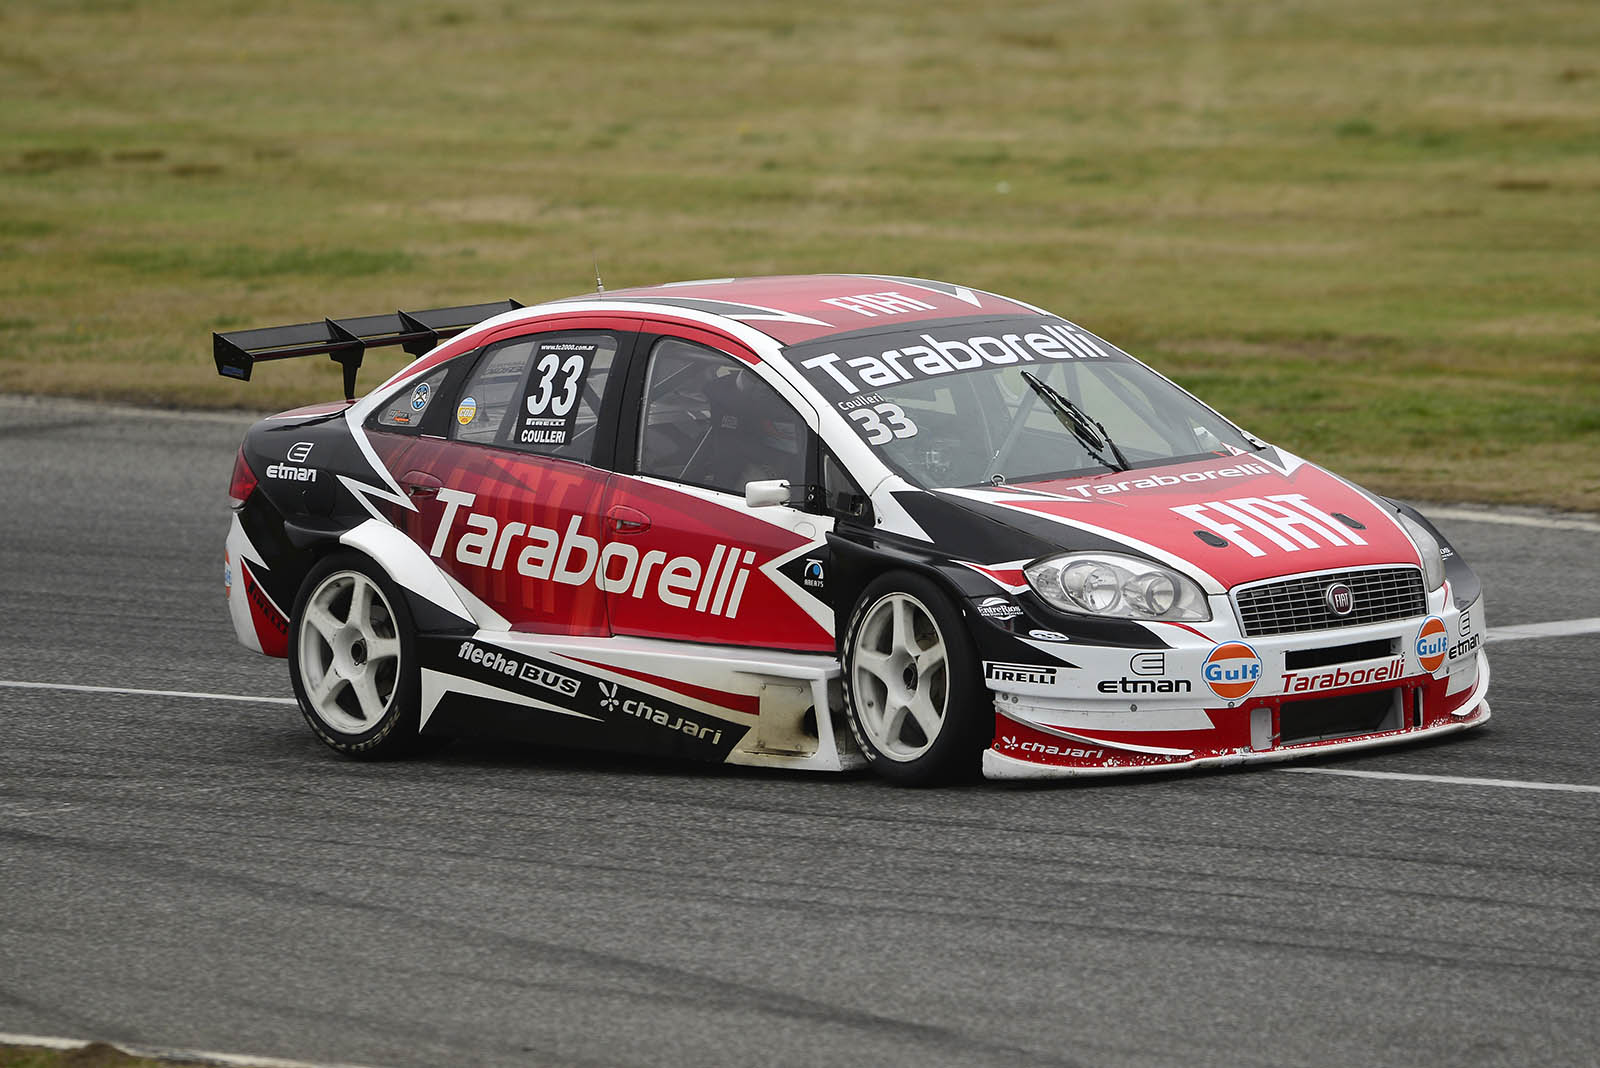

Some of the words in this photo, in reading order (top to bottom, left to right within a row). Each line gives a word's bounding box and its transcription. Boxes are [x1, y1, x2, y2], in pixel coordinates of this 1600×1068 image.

[819, 292, 937, 317] FIAT
[801, 324, 1110, 395] Taraborelli
[527, 353, 585, 417] 33
[837, 392, 885, 411] Coulleri
[521, 429, 566, 444] COULLERI
[848, 403, 918, 446] 33
[266, 462, 317, 482] etman
[1066, 462, 1271, 498] Taraborelli
[1170, 493, 1369, 557] FIAT
[430, 488, 755, 618] Taraborelli
[1333, 591, 1350, 608] FIAT
[1418, 636, 1447, 656] Gulf
[1449, 631, 1480, 660] etman
[458, 642, 516, 676] flecha
[523, 666, 578, 695] BUS
[986, 663, 1057, 685] PIRELLI
[1205, 664, 1259, 681] Gulf
[1281, 658, 1407, 693] Taraborelli
[1097, 677, 1192, 694] etman
